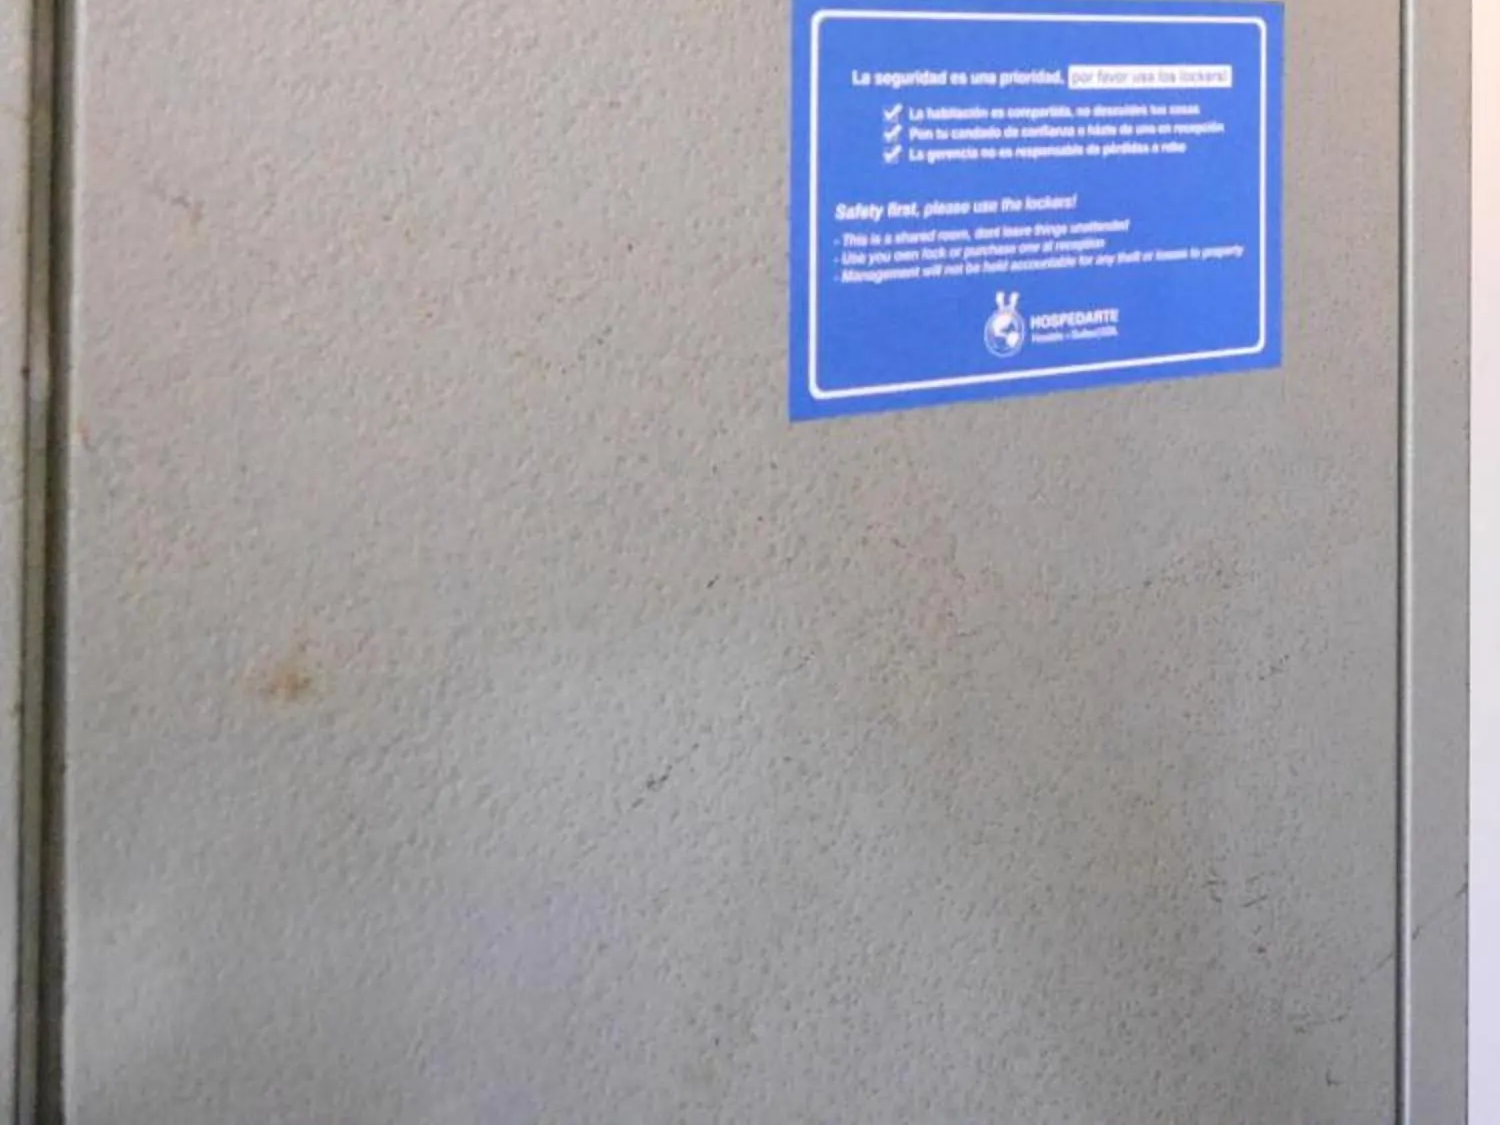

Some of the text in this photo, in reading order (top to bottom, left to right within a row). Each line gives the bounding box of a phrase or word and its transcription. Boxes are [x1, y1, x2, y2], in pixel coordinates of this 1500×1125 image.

[852, 69, 871, 86] La
[874, 69, 947, 90] seguridad
[951, 72, 967, 86] es
[970, 72, 997, 85] una
[1071, 71, 1093, 85] por
[1097, 68, 1127, 83] favor
[909, 147, 924, 162] La
[835, 202, 883, 222] Safety
[923, 198, 971, 219] please
[973, 199, 998, 214] use
[1001, 196, 1023, 213] the
[1025, 192, 1078, 211] lockers!
[843, 232, 868, 247] This
[1029, 307, 1120, 330] HOSPEDARTE
